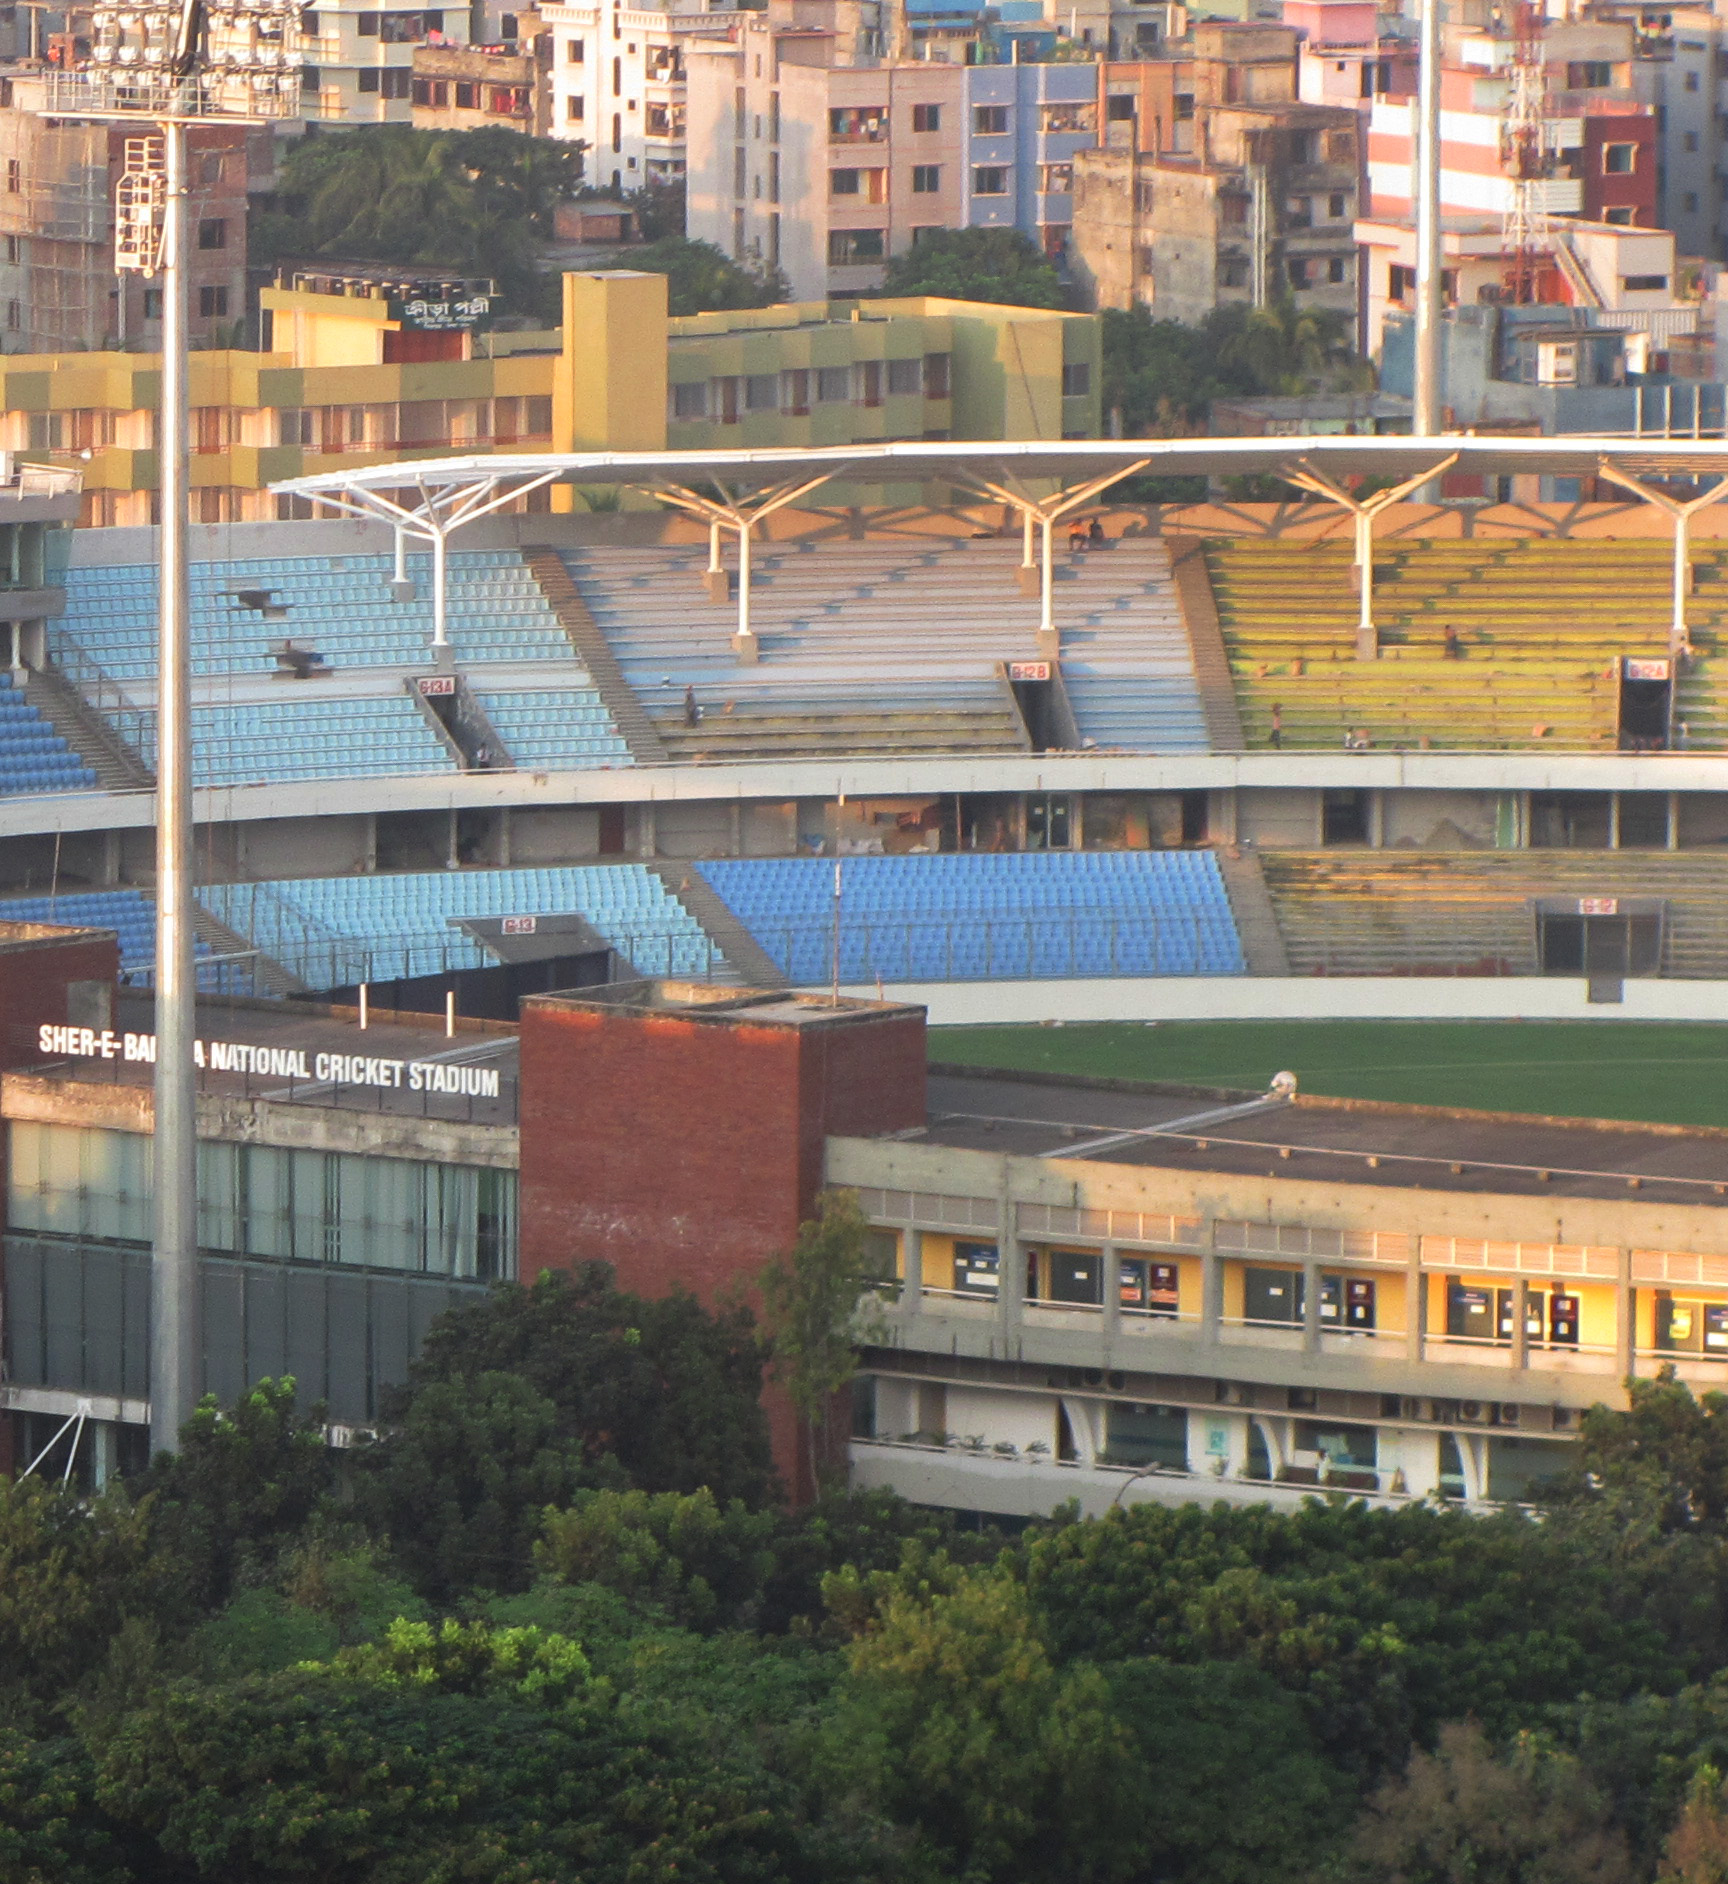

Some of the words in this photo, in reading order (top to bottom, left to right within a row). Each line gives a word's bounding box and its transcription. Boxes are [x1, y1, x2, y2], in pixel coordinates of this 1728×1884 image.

[210, 1041, 311, 1080] NATIONAL
[315, 1052, 405, 1088] CRICKET
[409, 1062, 500, 1098] STADIUM
